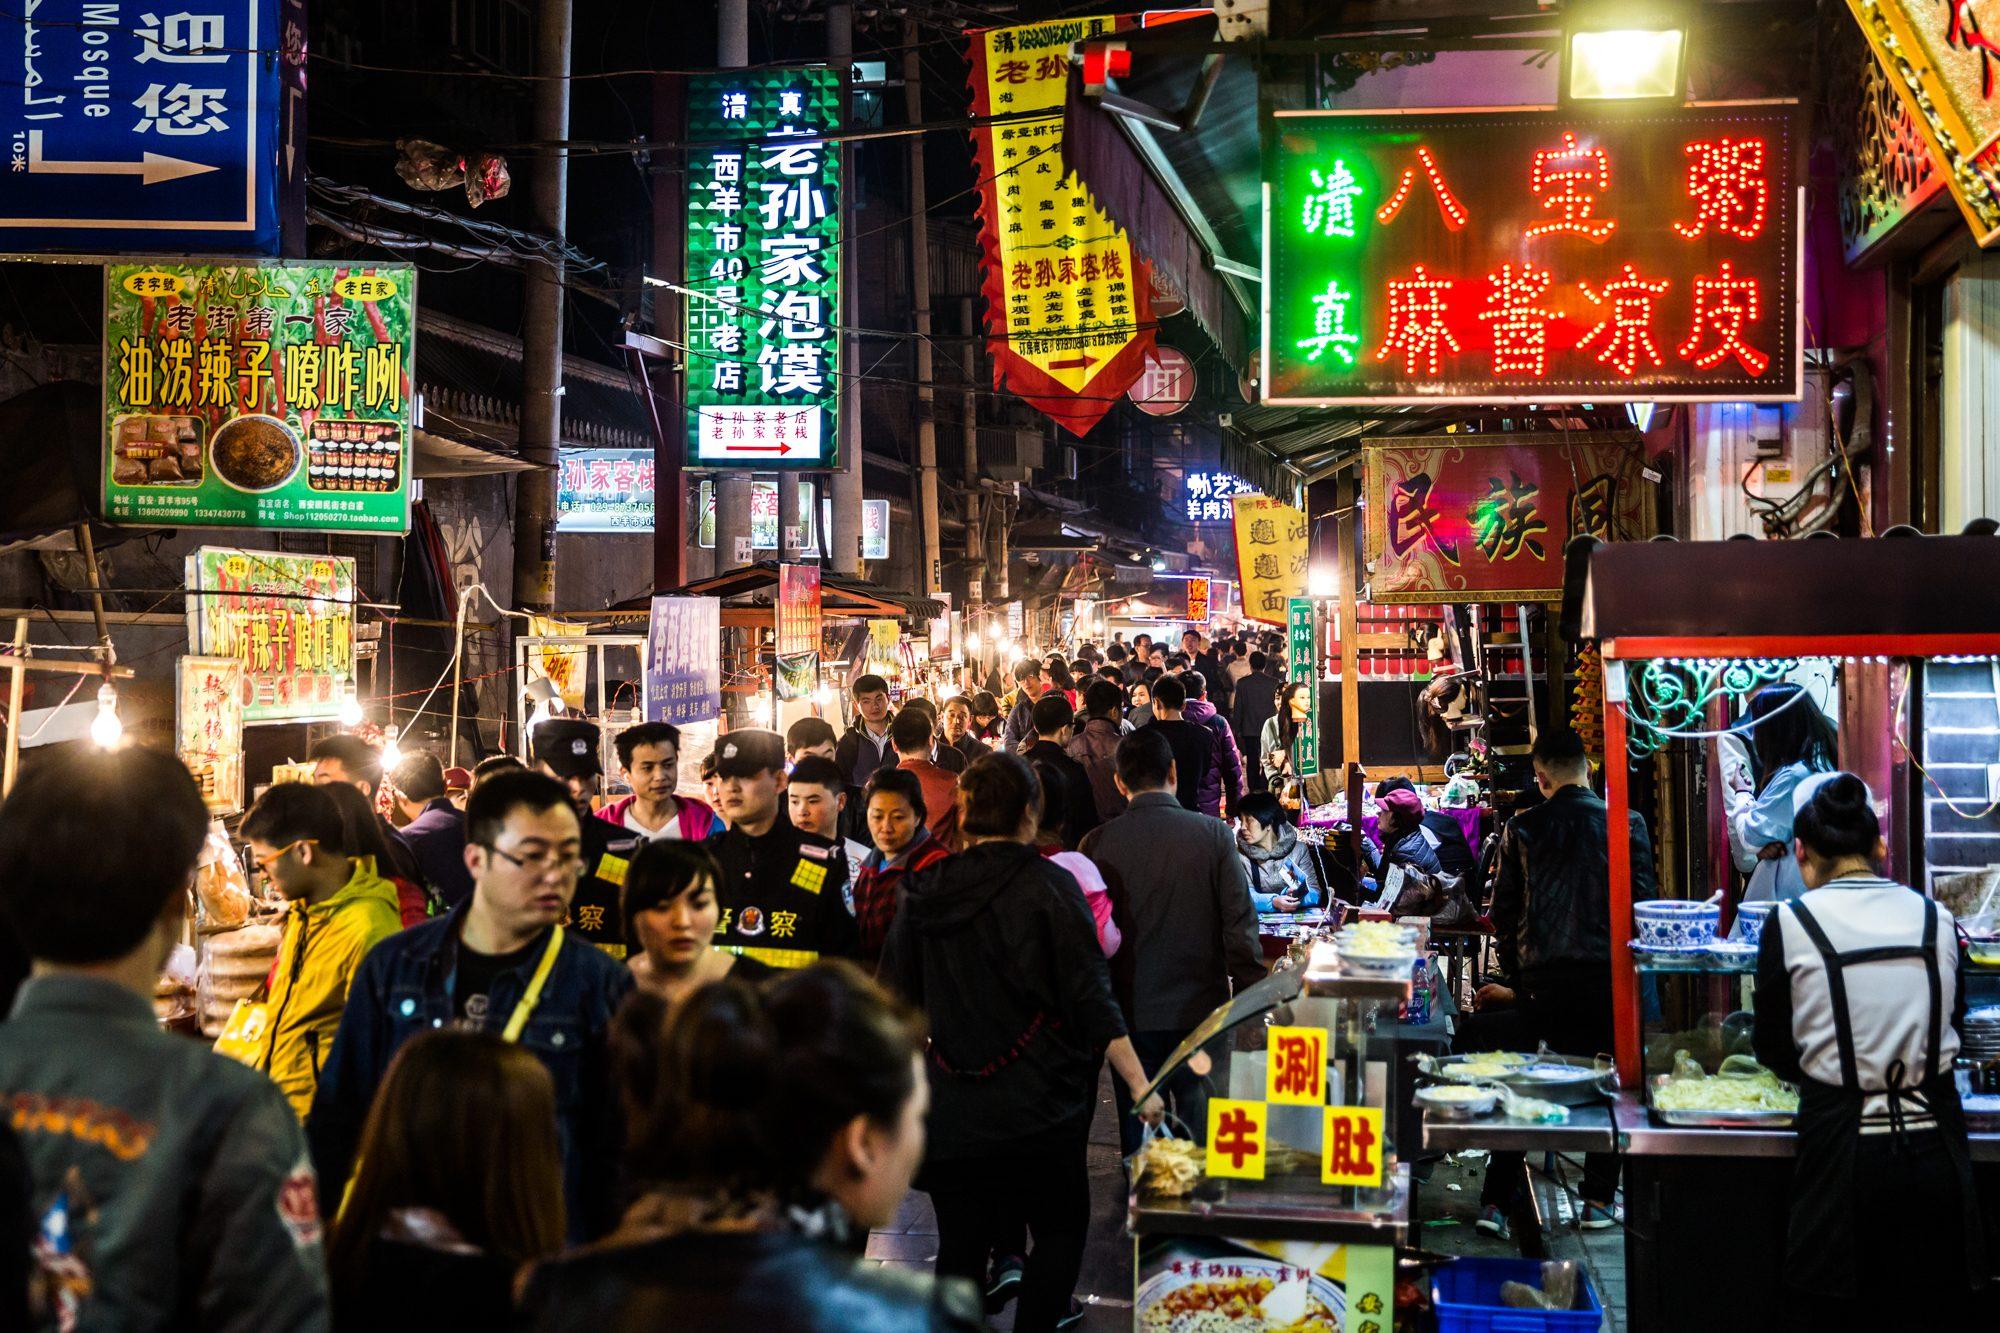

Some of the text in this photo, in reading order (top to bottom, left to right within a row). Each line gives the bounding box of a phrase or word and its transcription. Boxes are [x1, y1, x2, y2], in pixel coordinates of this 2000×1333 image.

[74, 3, 119, 117] Mosque
[993, 31, 1016, 53] 清
[132, 11, 230, 136] 迎您
[1376, 131, 1768, 241] 八宝粥
[711, 153, 743, 390] 西羊市40号老店
[756, 125, 827, 395] 老孙家泡馍
[1011, 249, 1125, 290] 老孙家客栈
[344, 281, 389, 296] 老白家
[1011, 282, 1126, 304] 中央空调
[166, 304, 354, 335] 老街第一家
[1375, 260, 1770, 377] 麻酱凉皮
[711, 411, 808, 425] 老孙家老店
[711, 426, 808, 439] 老孙家客栈
[610, 516, 655, 528] 西羊市40
[579, 903, 606, 931] 察
[771, 910, 798, 938] 察
[1273, 1035, 1321, 1098] 涮
[1214, 1107, 1376, 1176] 牛 肚
